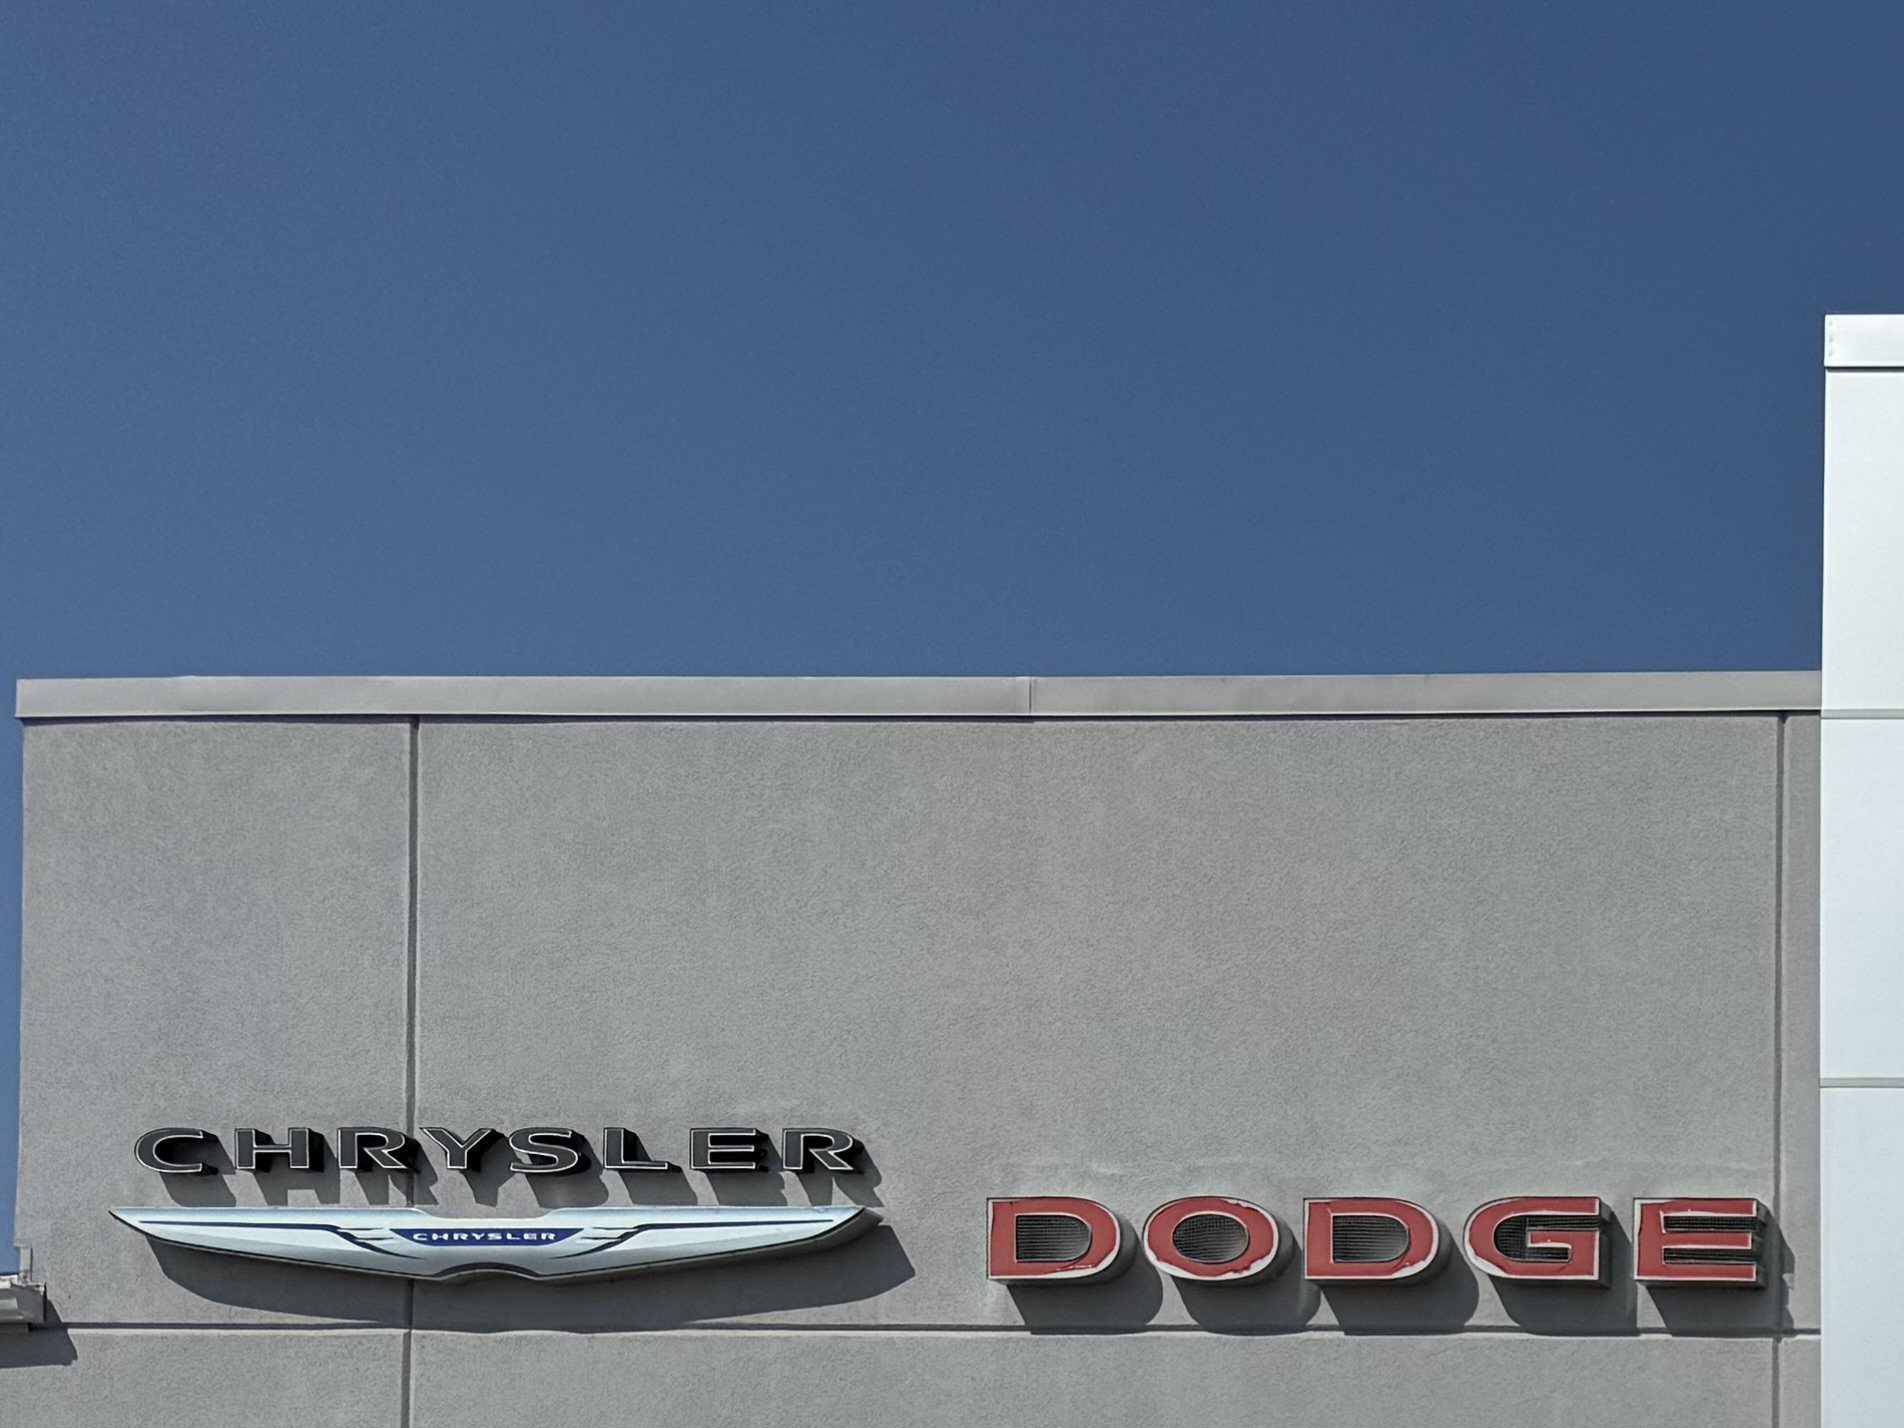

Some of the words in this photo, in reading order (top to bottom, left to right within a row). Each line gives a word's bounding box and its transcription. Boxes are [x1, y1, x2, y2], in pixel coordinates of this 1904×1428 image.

[134, 1127, 864, 1176] CHRYSLER
[412, 1232, 557, 1242] CHRYSLER
[987, 1197, 1766, 1286] DODGE
